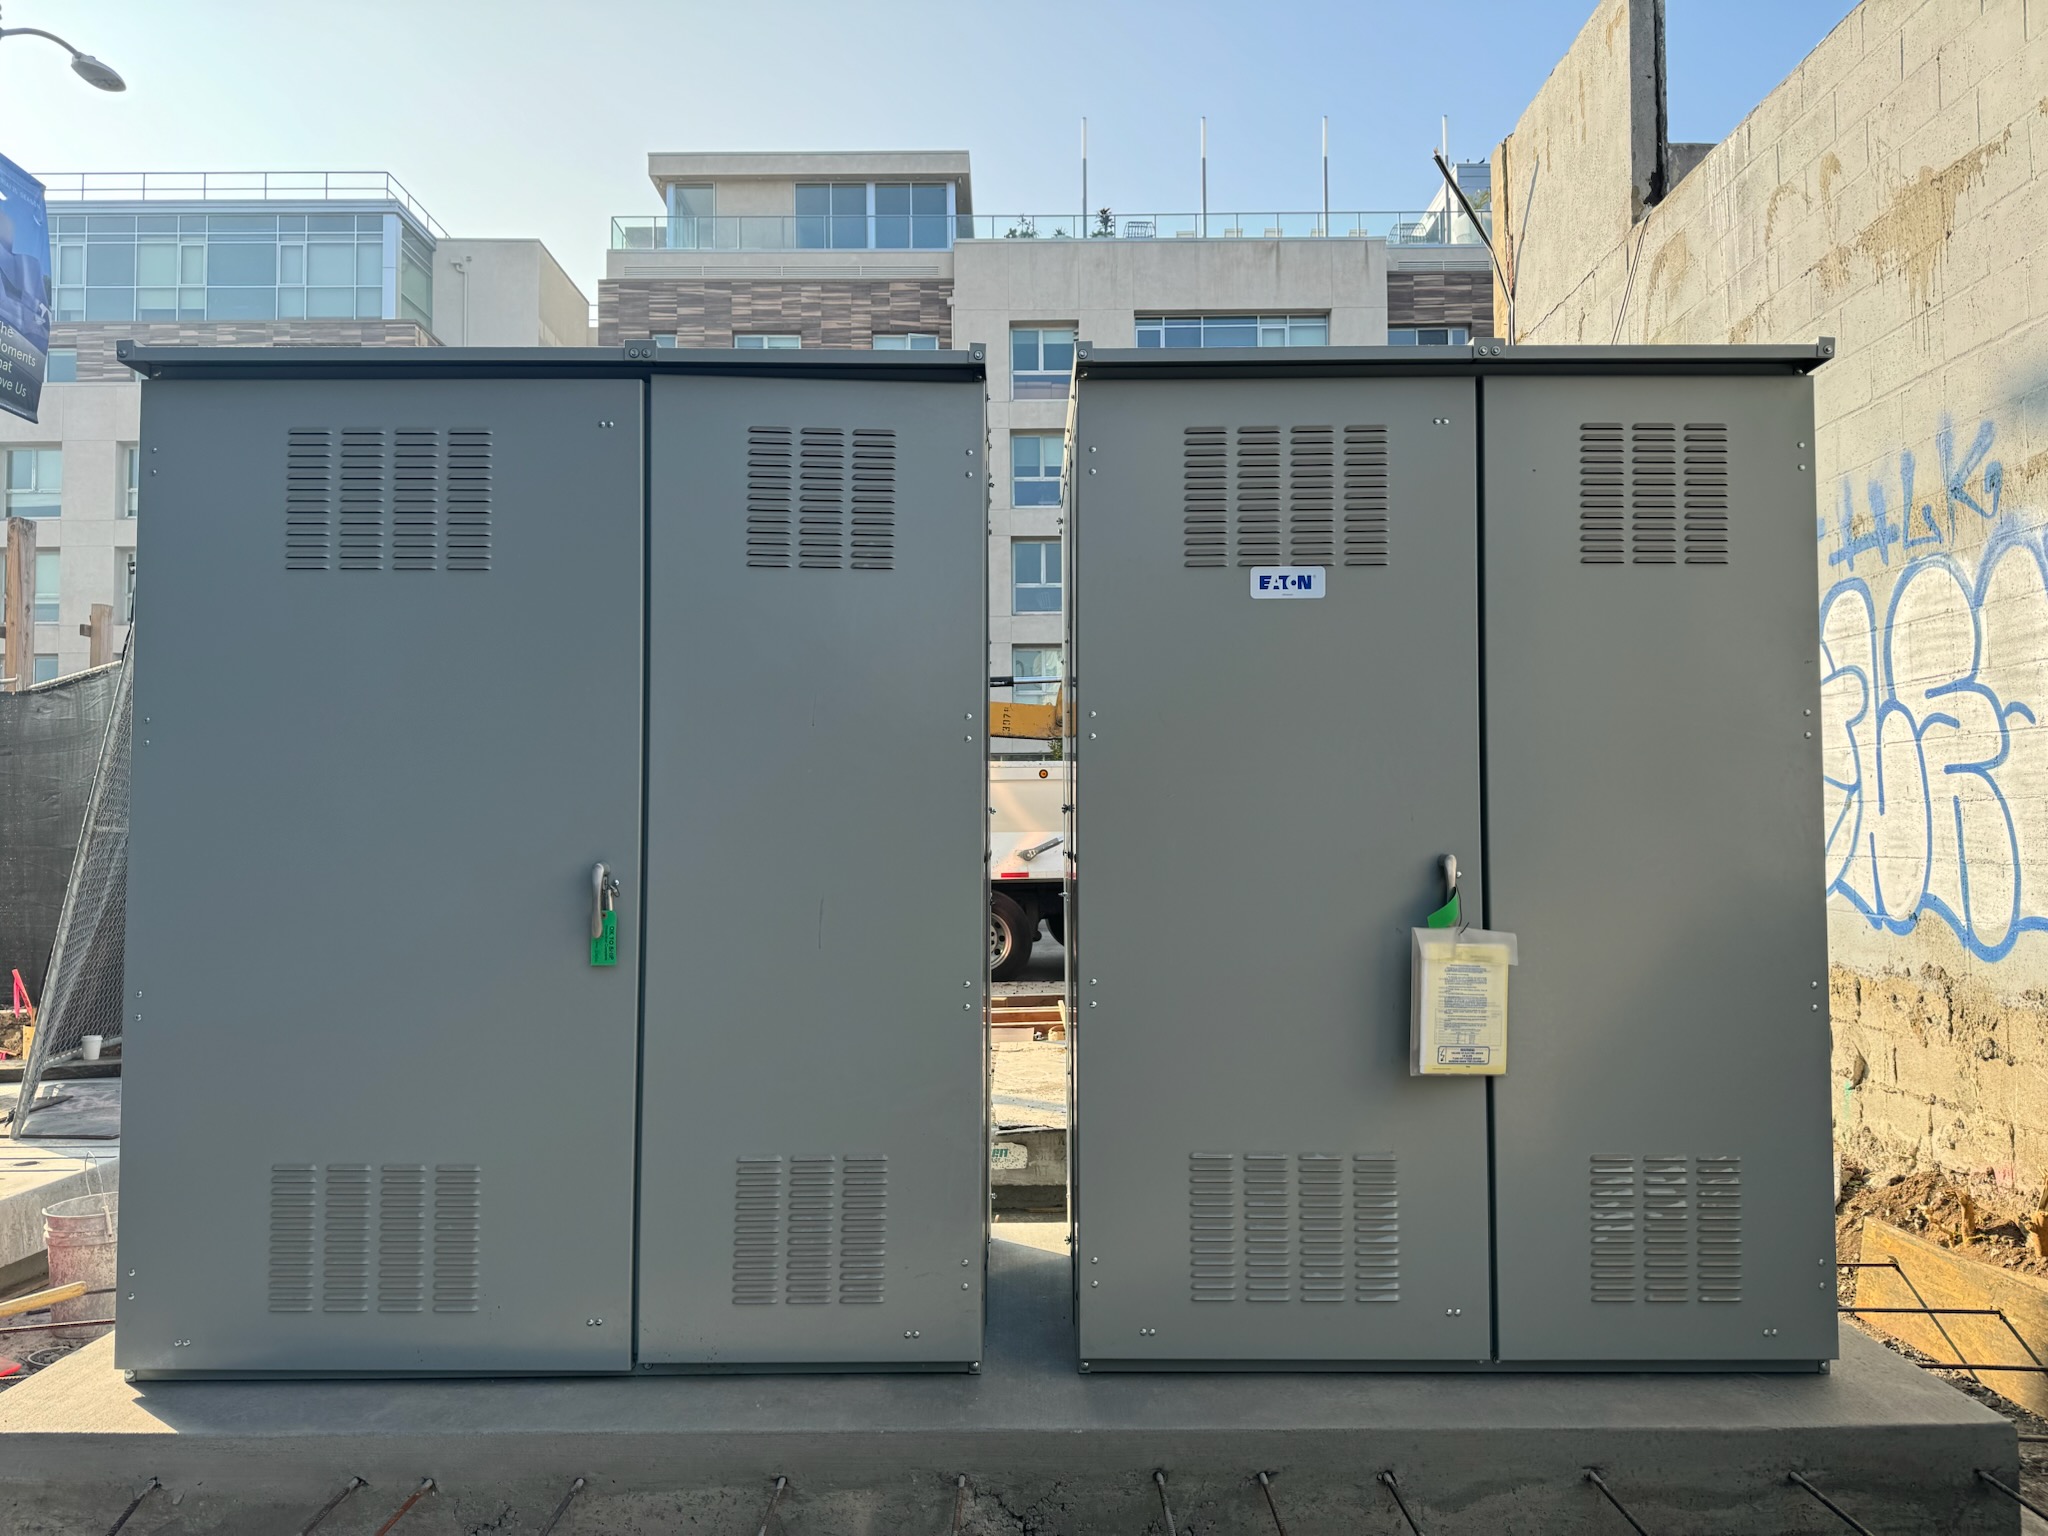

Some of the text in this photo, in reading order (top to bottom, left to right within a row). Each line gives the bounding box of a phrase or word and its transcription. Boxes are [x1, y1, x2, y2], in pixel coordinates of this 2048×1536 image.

[0, 320, 14, 338] he
[0, 338, 36, 367] oments
[15, 381, 27, 397] Us
[1259, 575, 1312, 590] EATON
